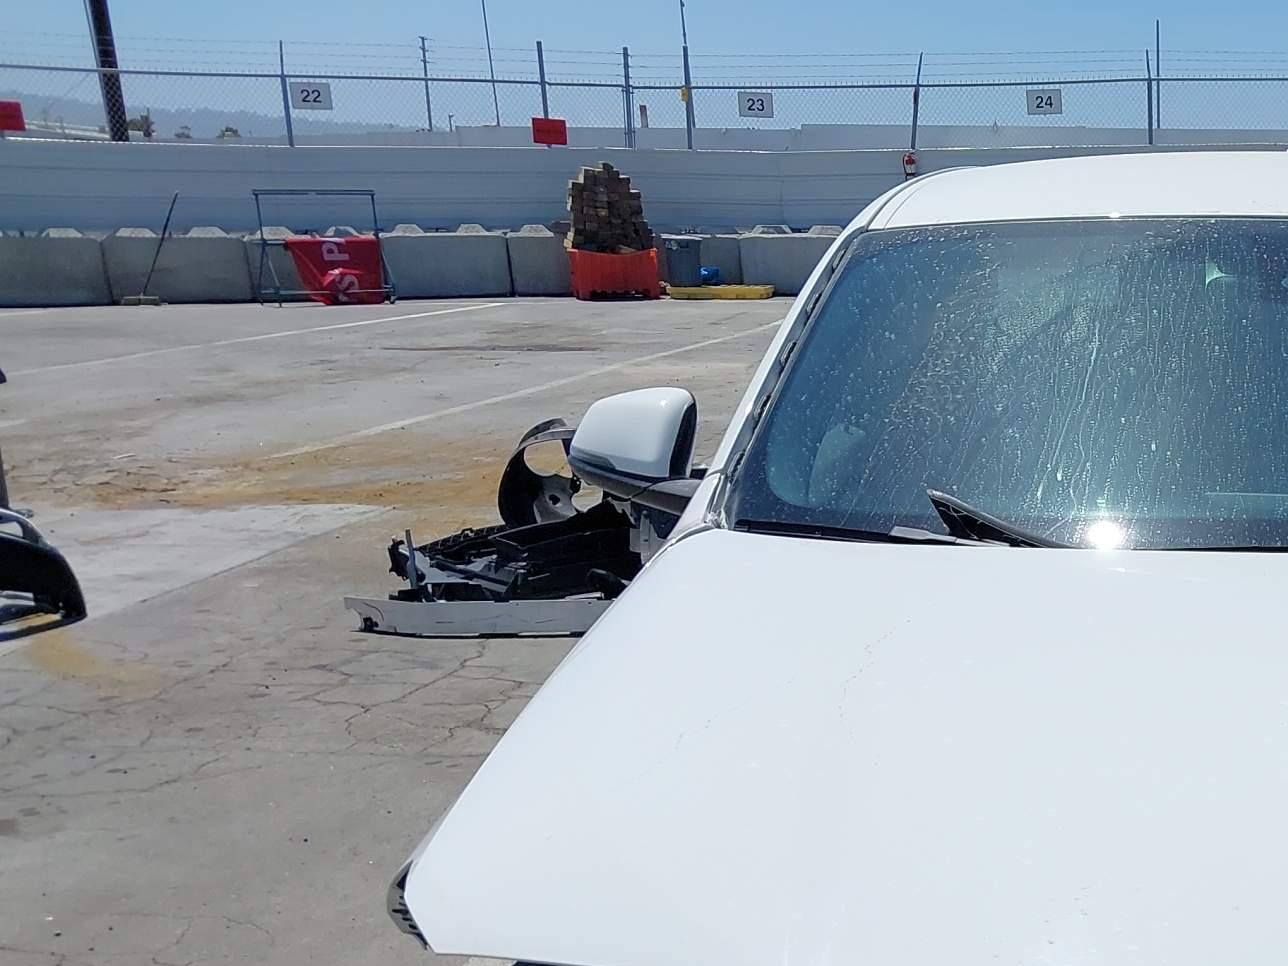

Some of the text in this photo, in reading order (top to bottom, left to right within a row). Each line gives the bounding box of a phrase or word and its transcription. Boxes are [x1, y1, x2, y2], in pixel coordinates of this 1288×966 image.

[300, 89, 323, 104] 22
[1035, 95, 1054, 109] 24
[746, 97, 765, 112] 23
